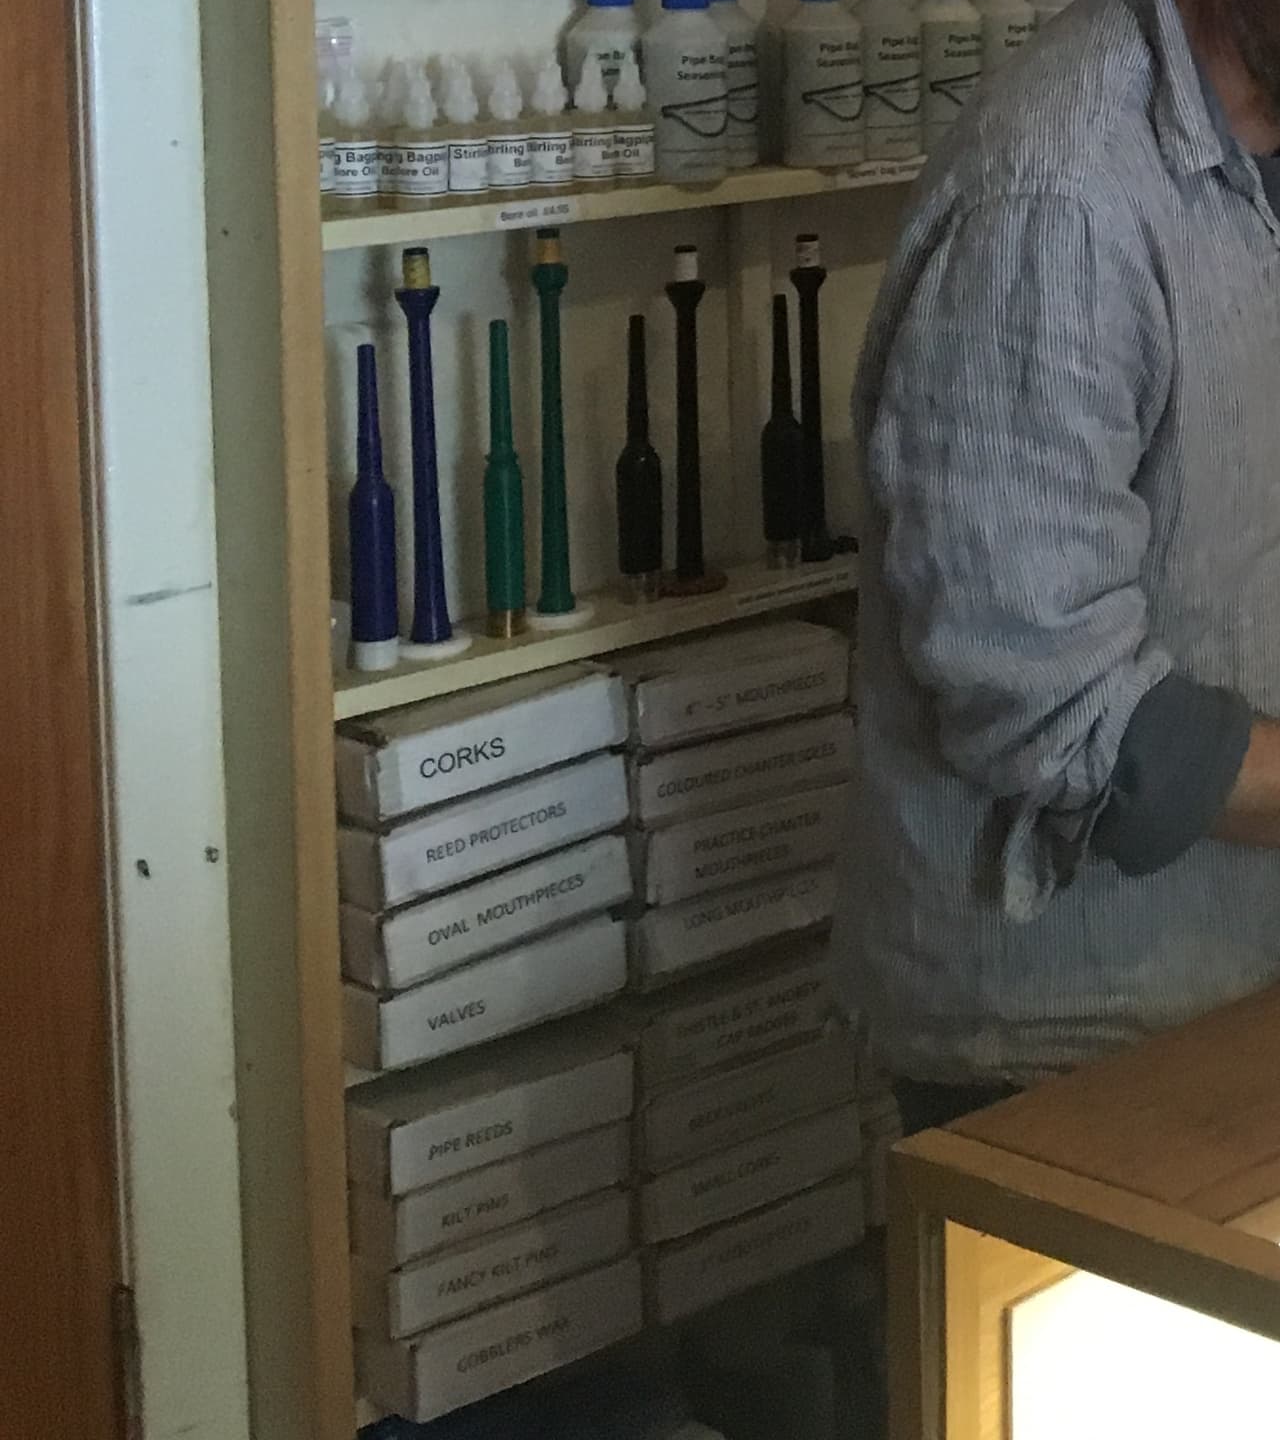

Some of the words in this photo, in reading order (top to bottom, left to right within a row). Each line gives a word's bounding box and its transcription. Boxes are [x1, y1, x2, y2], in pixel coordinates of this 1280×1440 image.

[735, 671, 826, 704] MOUTHPIECES
[419, 736, 507, 779] CORKS
[425, 837, 467, 864] REED
[469, 800, 568, 848] PROTECTORS
[694, 827, 754, 853] PRACTICE
[427, 918, 471, 947] OVAL
[476, 872, 585, 928] MOUTHPIECES
[426, 998, 487, 1032] VALVES
[428, 1137, 460, 1161] PIPE
[463, 1120, 514, 1149] REEDS
[440, 1205, 472, 1228] KILT
[475, 1193, 509, 1215] PINS
[437, 1270, 486, 1297] FANCY
[489, 1256, 521, 1278] KILT
[456, 1330, 533, 1374] COBBLERS
